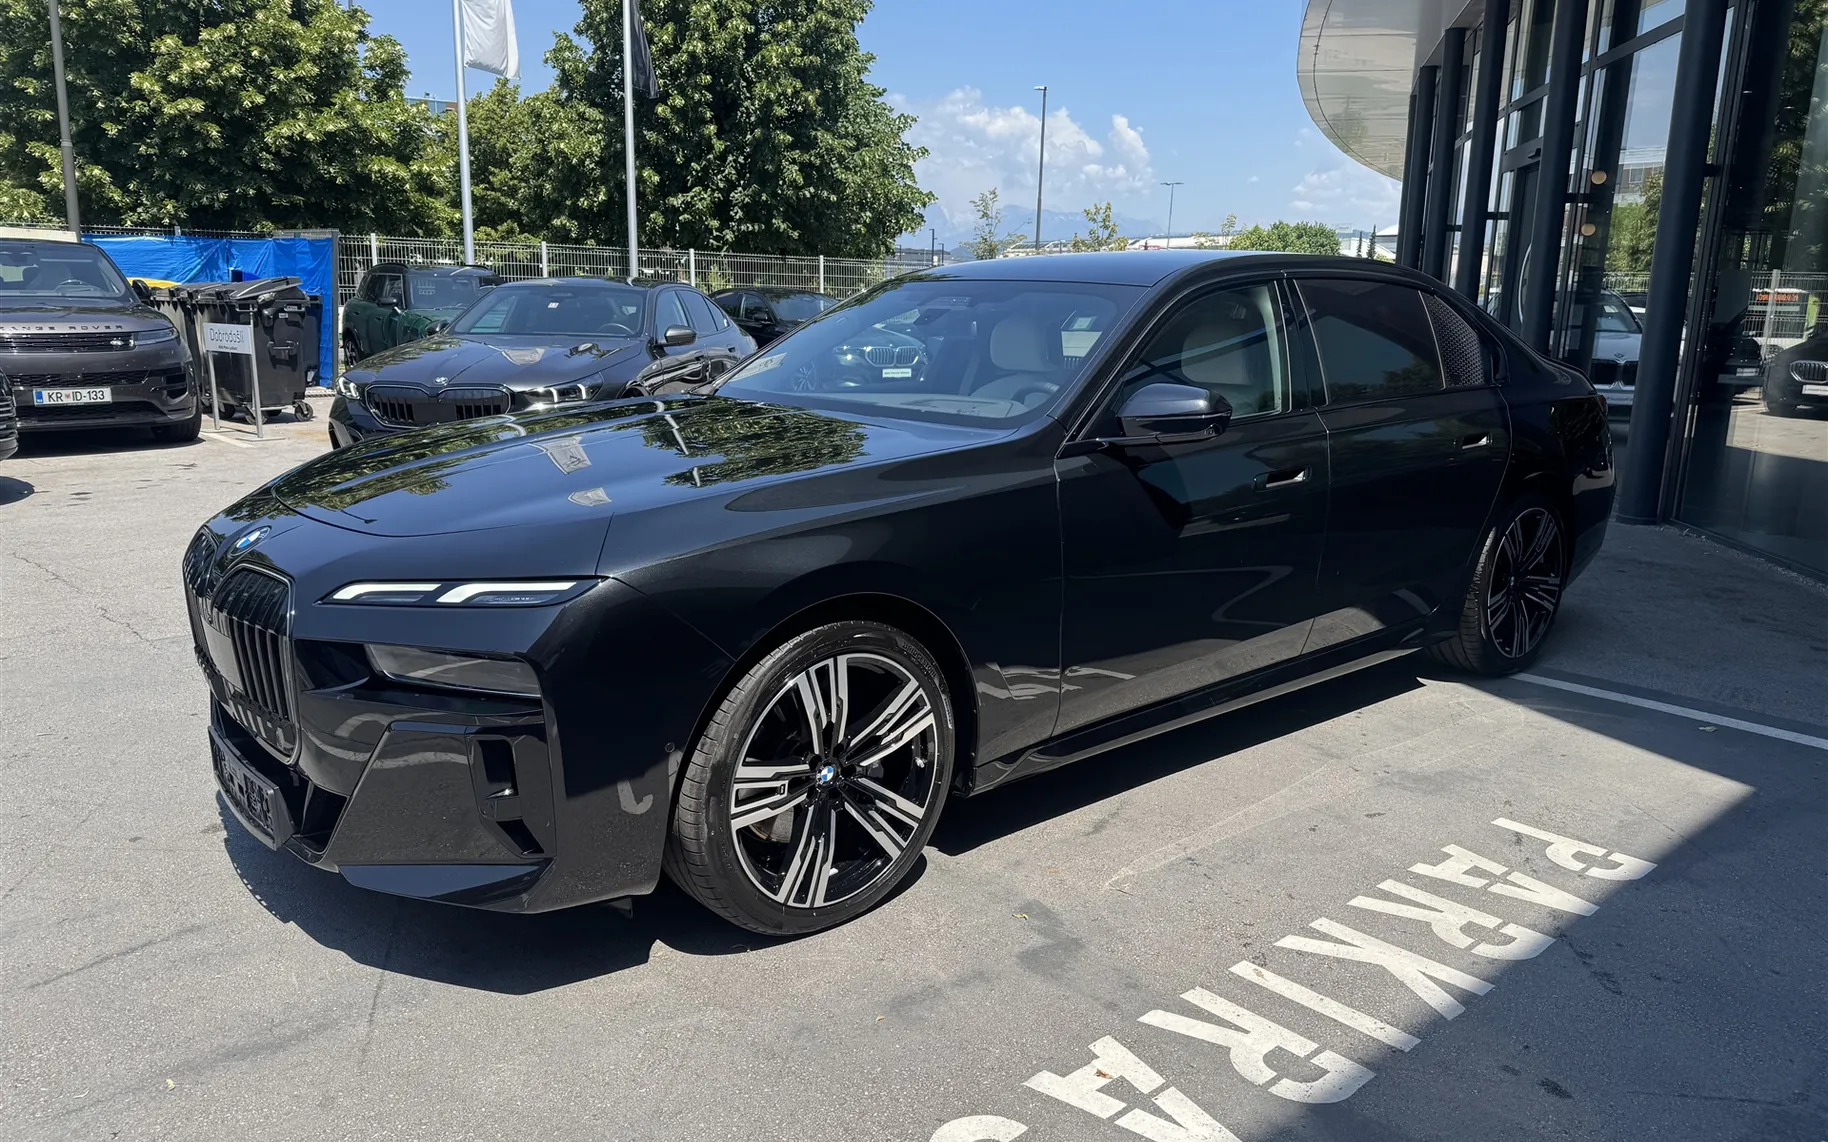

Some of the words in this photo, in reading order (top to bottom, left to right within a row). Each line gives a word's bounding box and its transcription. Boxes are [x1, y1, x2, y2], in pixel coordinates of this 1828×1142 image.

[47, 392, 64, 403] KR
[71, 390, 105, 402] ID-133
[929, 817, 1659, 1142] PARKIRA
